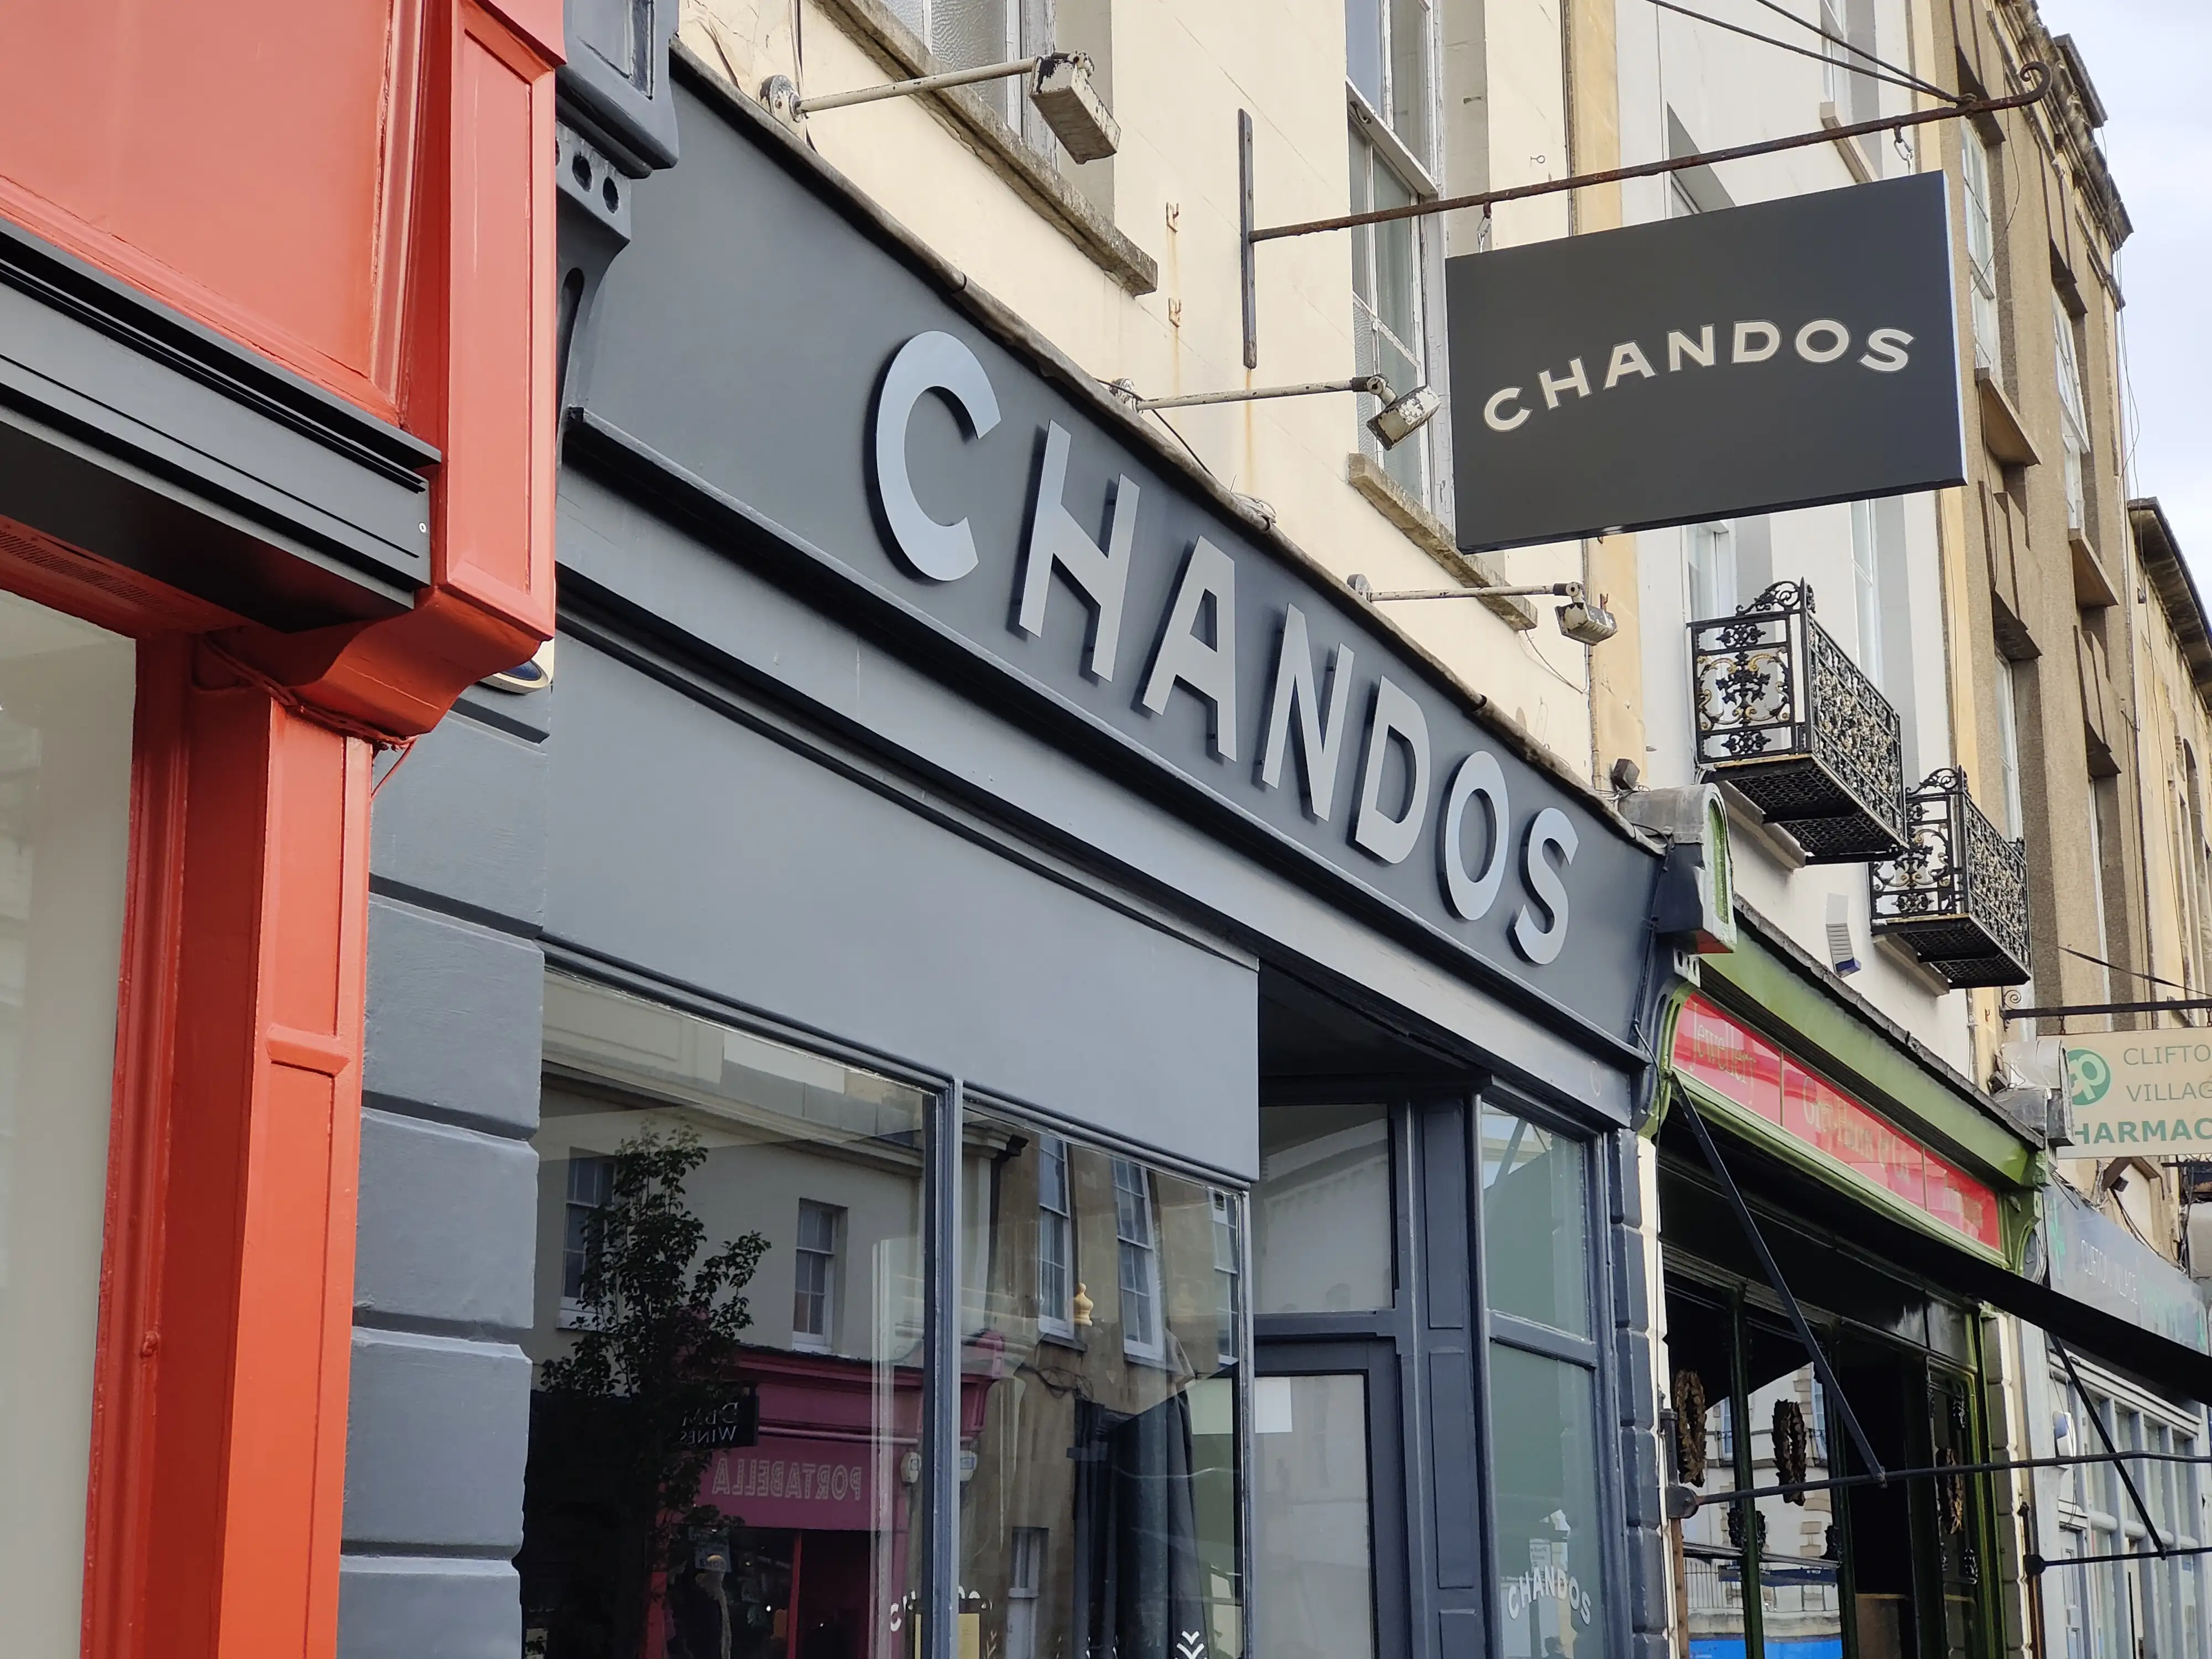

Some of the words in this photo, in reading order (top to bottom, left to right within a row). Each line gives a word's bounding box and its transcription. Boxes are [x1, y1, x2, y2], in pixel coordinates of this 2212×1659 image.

[1483, 317, 1916, 432] CHANDOS
[875, 330, 1578, 966] CHANDOS
[2123, 1044, 2211, 1066] CLIFTO
[2126, 1081, 2212, 1102] VILLAG
[1507, 1565, 1592, 1625] CHANDOS
